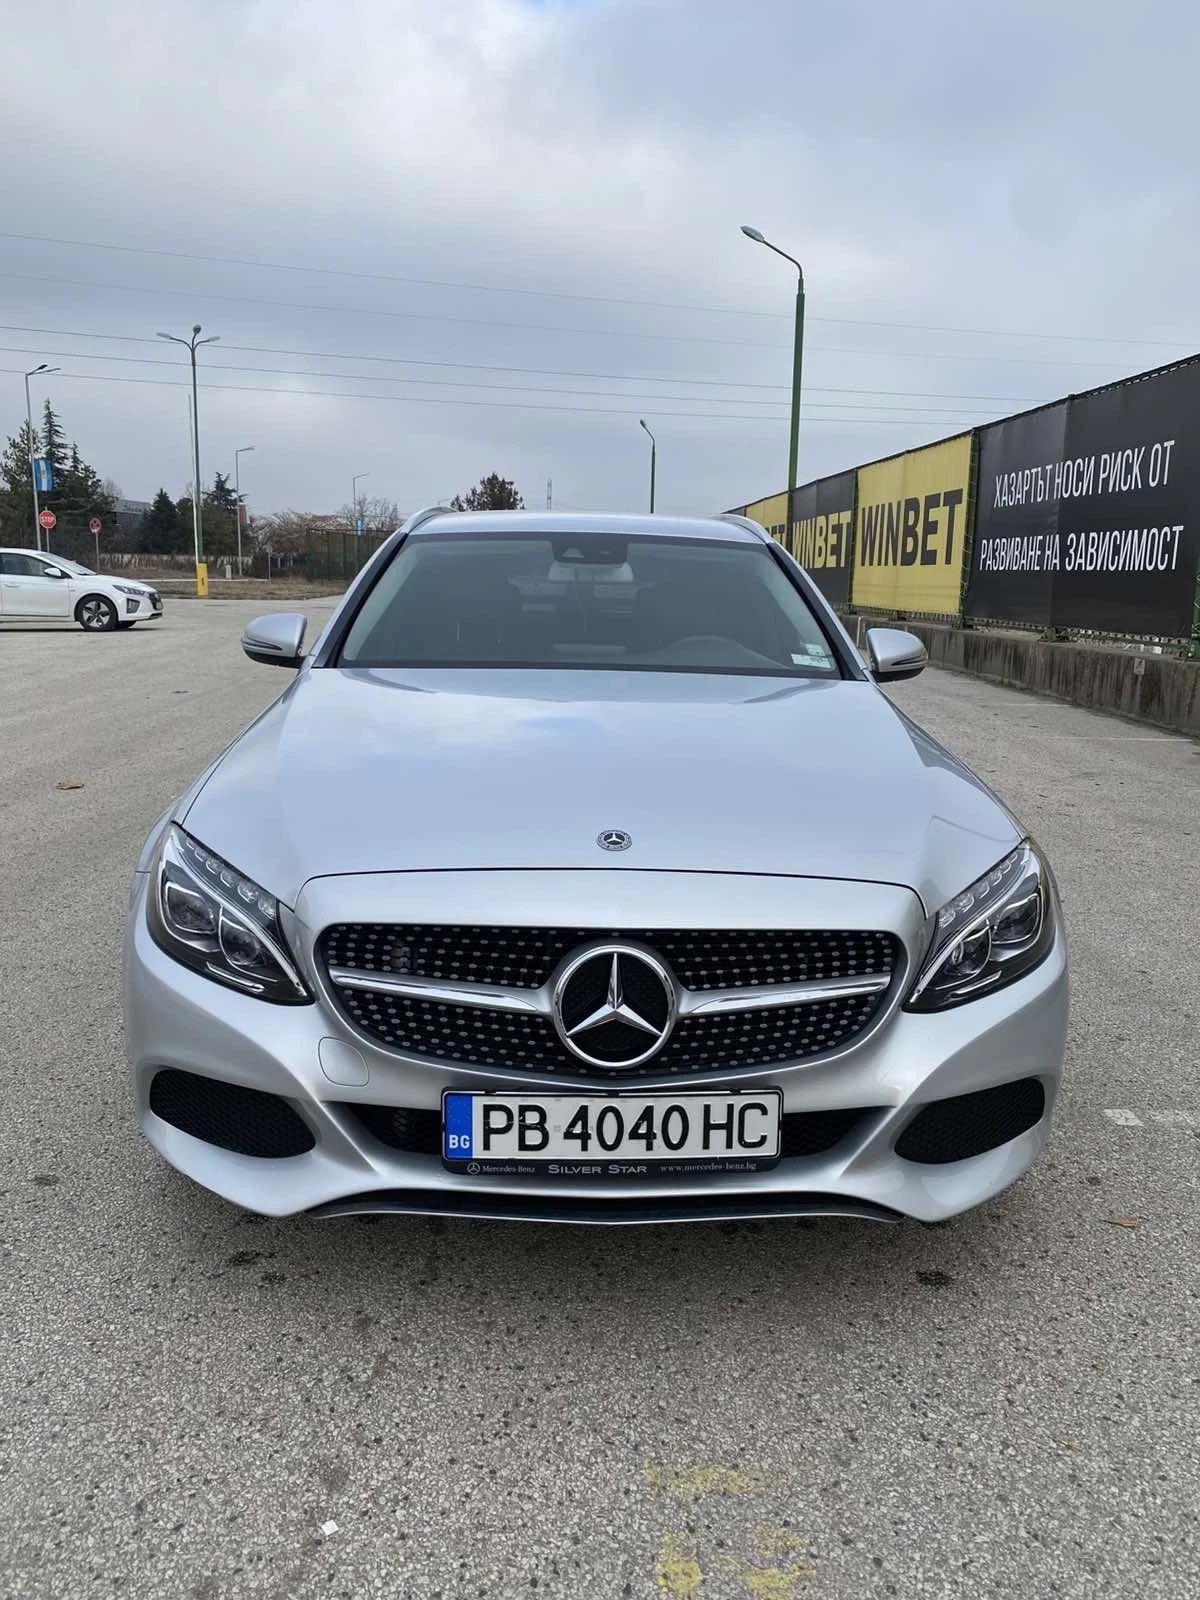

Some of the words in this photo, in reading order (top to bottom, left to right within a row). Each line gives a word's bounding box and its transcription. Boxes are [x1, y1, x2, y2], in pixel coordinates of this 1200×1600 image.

[994, 464, 1053, 508] ХАЗАРТЪТ
[1053, 456, 1095, 500] НОСИ
[1098, 446, 1146, 494] РИСК
[1148, 439, 1175, 487] ОТ
[793, 510, 851, 569] WINBET
[861, 488, 963, 567] WINBET
[979, 535, 1043, 571] РАЗВИВАНЕ
[1043, 534, 1060, 571] НА
[1065, 525, 1184, 571] ЗАВИСИМОСТ
[449, 1135, 470, 1149] BG
[482, 1103, 550, 1151] PB
[563, 1104, 690, 1152] 4040
[702, 1103, 768, 1150] HC
